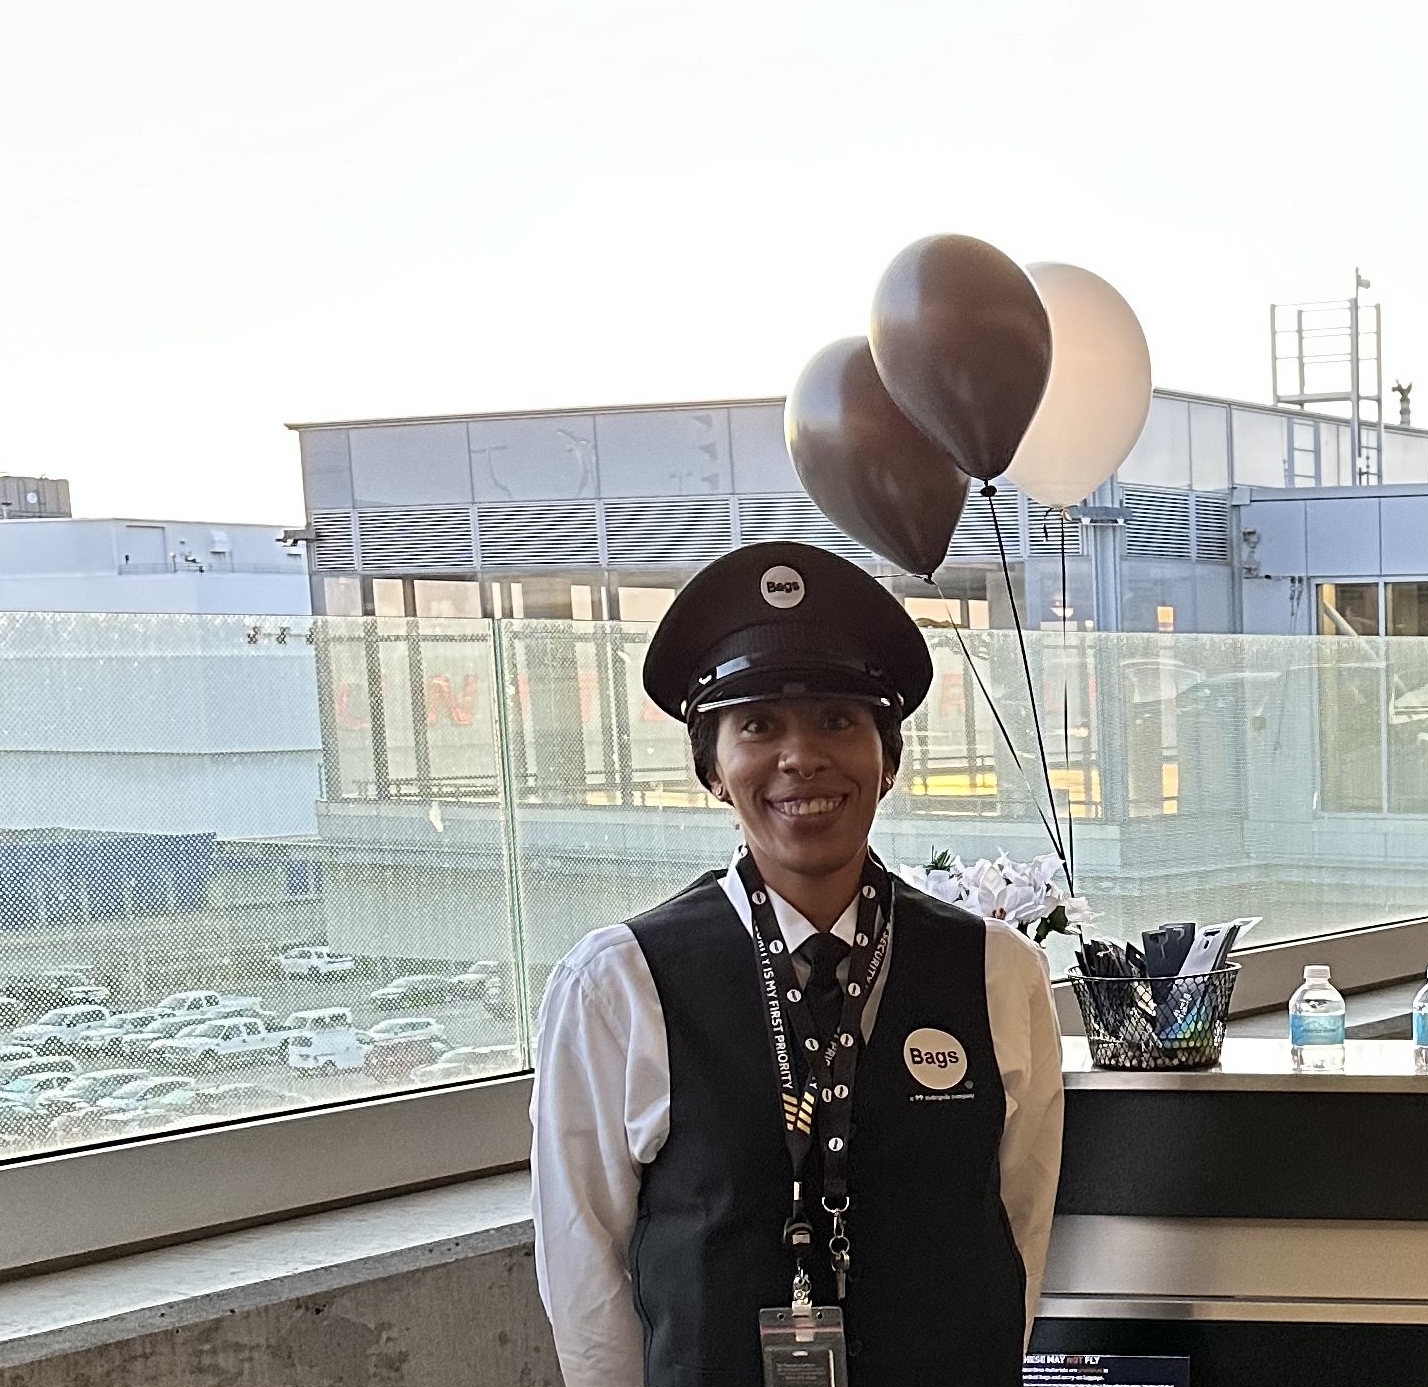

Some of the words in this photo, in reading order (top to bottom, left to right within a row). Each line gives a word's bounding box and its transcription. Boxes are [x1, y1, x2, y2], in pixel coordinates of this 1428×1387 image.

[767, 581, 800, 593] Bags
[763, 967, 775, 979] IS
[765, 980, 778, 998] MY
[769, 1000, 784, 1033] FIRST
[774, 1034, 793, 1089] PRIORITY
[910, 1048, 959, 1068] Bags
[1047, 1355, 1065, 1363] MAY
[1085, 1356, 1100, 1364] FLY
